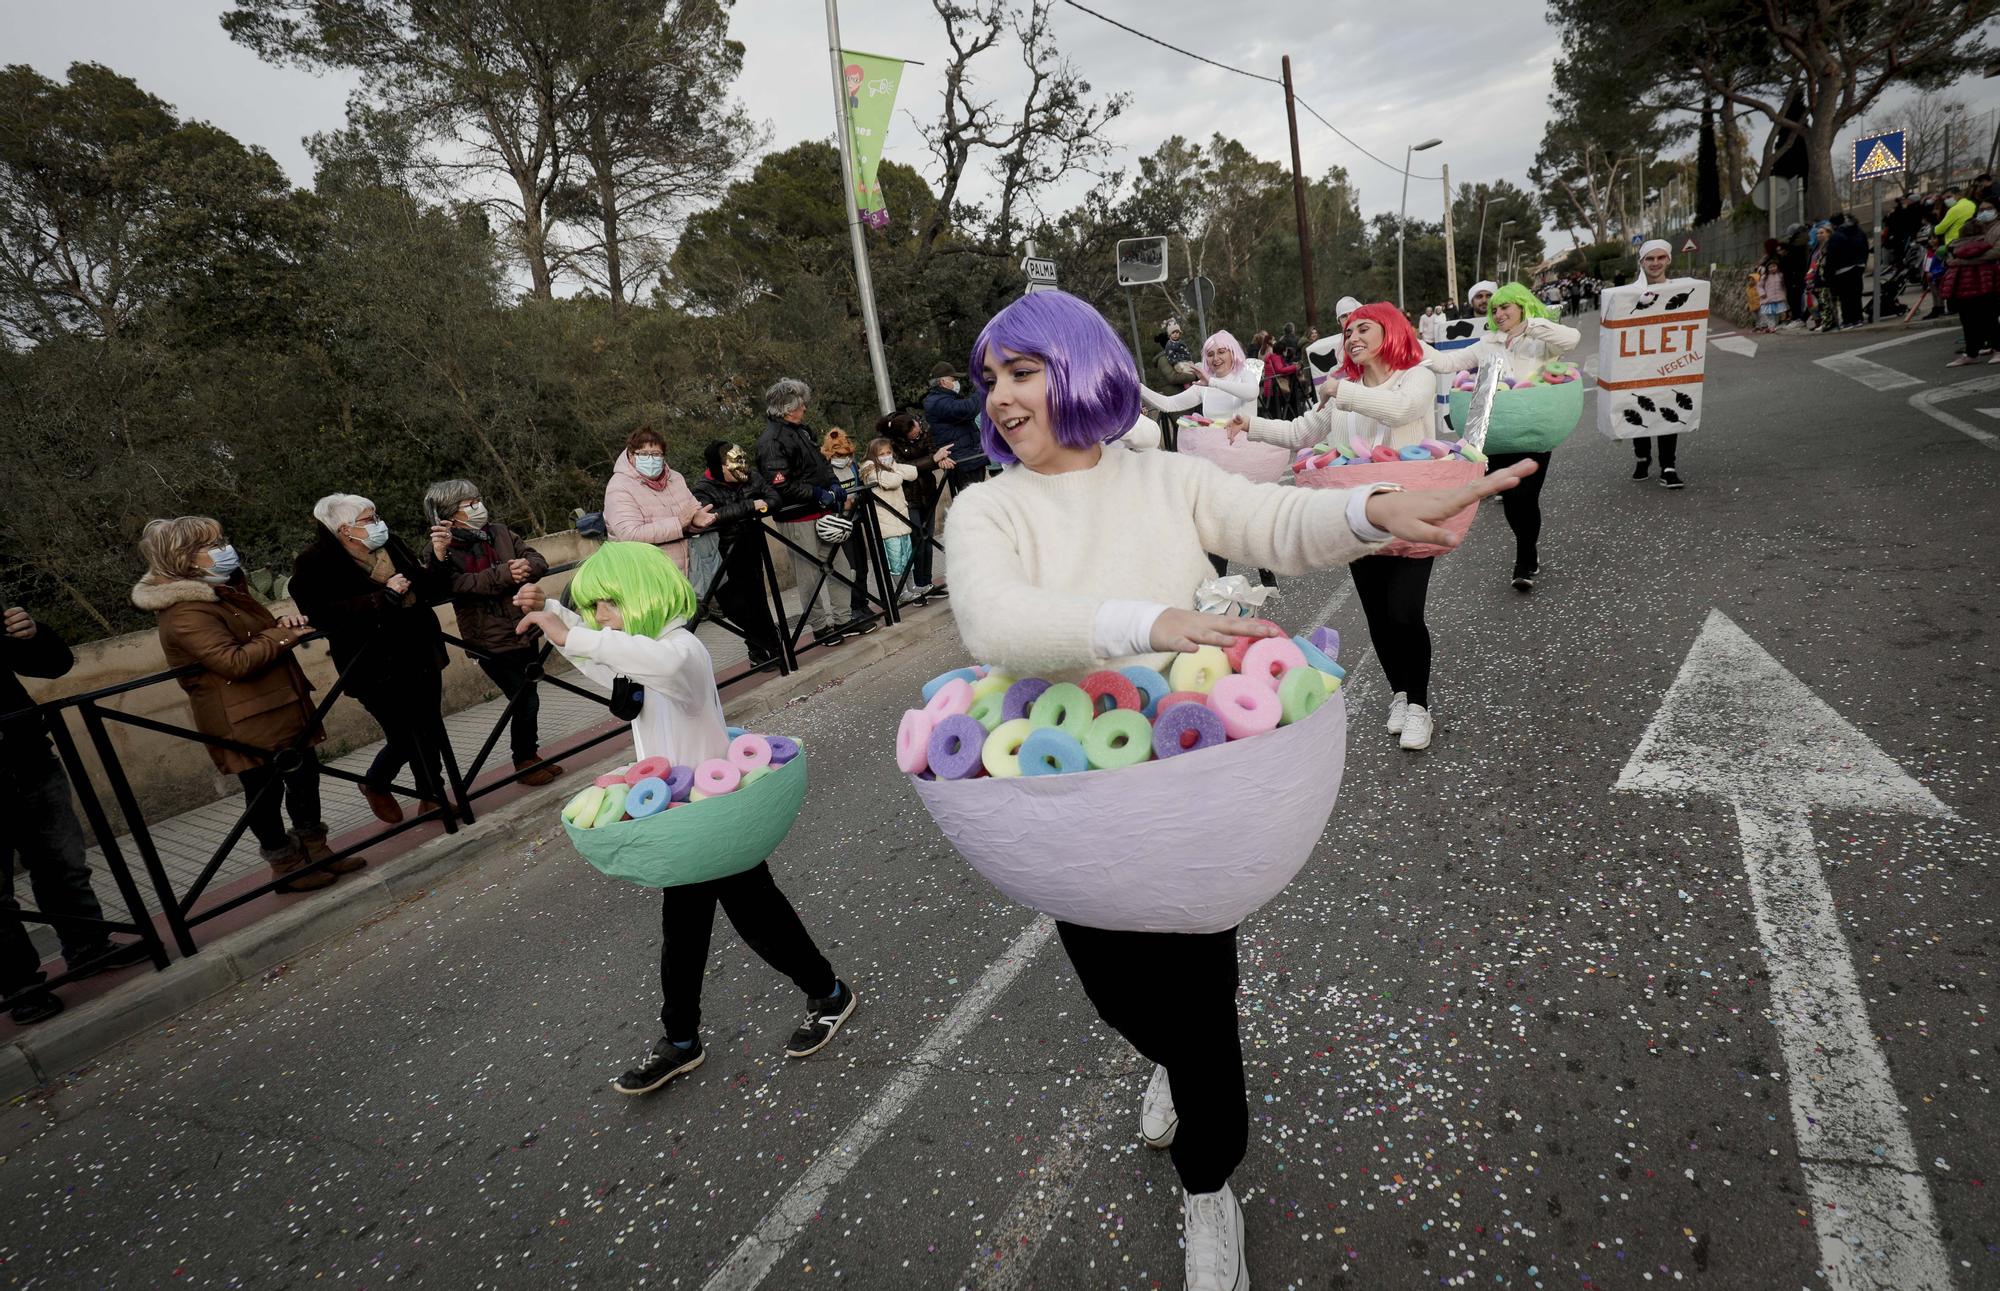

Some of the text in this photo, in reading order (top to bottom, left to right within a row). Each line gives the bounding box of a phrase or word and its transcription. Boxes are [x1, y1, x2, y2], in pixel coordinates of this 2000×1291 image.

[1030, 263, 1055, 277] PALMA
[1620, 324, 1699, 357] LLET
[1657, 351, 1703, 376] VEGETAL
